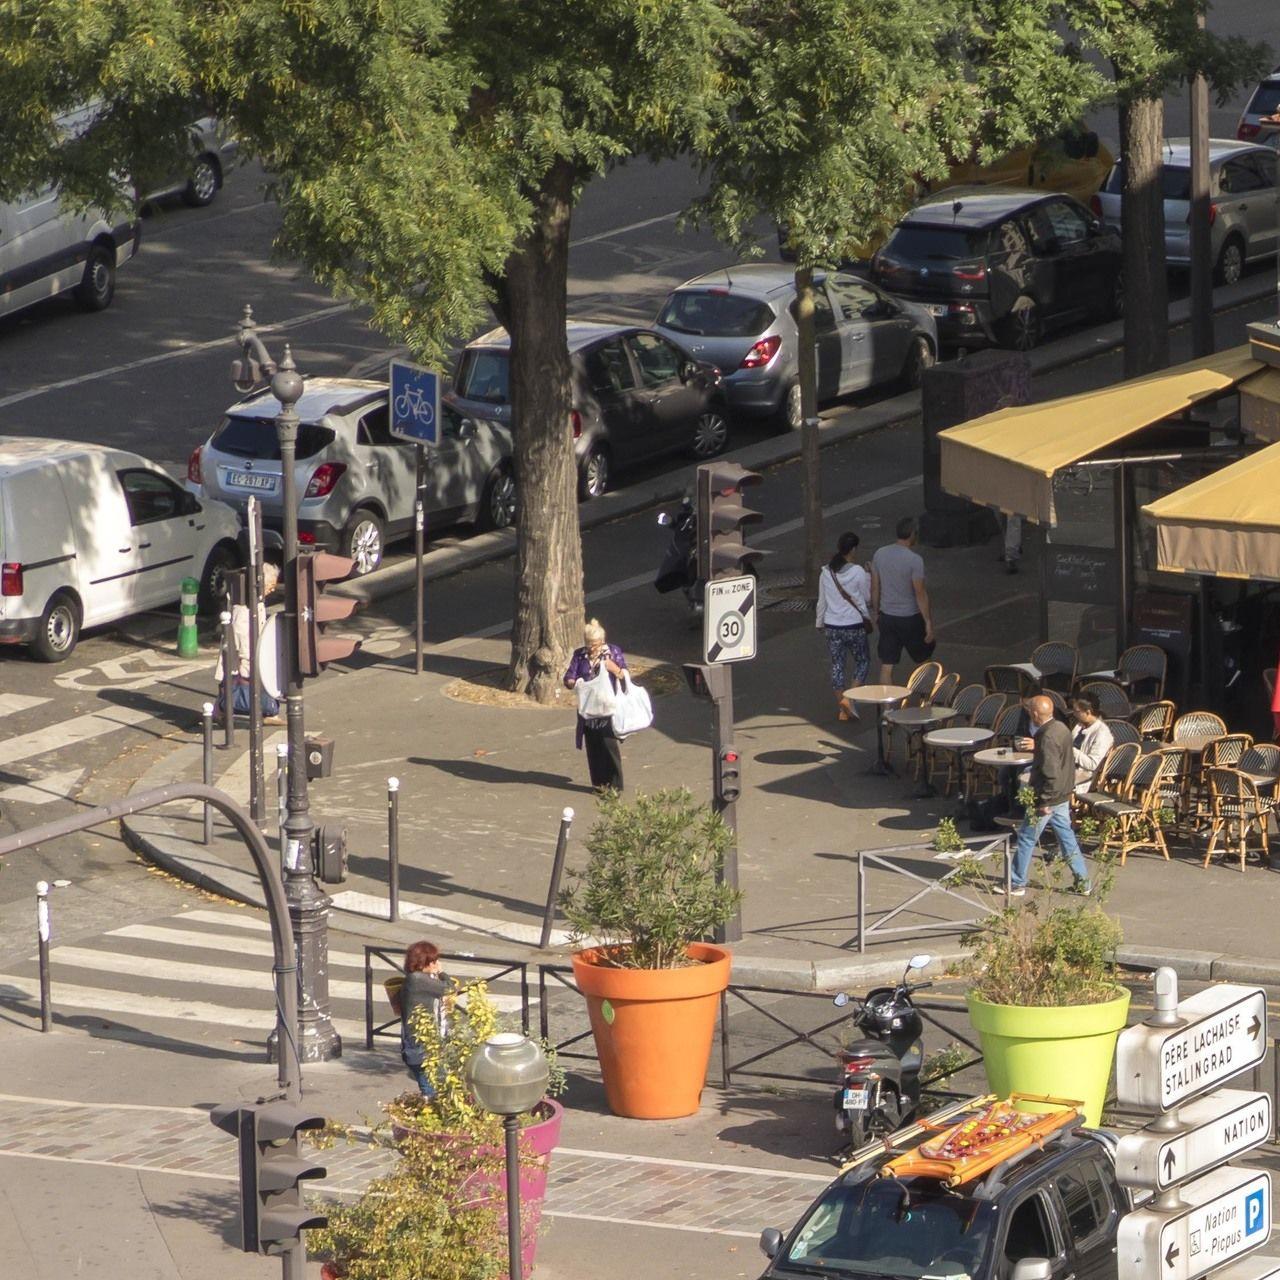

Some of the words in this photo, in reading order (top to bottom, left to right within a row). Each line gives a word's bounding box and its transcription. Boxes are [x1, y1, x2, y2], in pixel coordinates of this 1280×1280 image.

[712, 587, 724, 597] FIN
[732, 582, 751, 594] ZONE
[722, 621, 740, 638] 30
[1165, 1040, 1188, 1070] PÈRE
[1194, 1013, 1240, 1054] LACHAISE
[1165, 1045, 1233, 1096] STALINGRAD
[1224, 1109, 1264, 1145] NATION
[1204, 1205, 1237, 1233] Nation
[1211, 1229, 1242, 1256] Picpus
